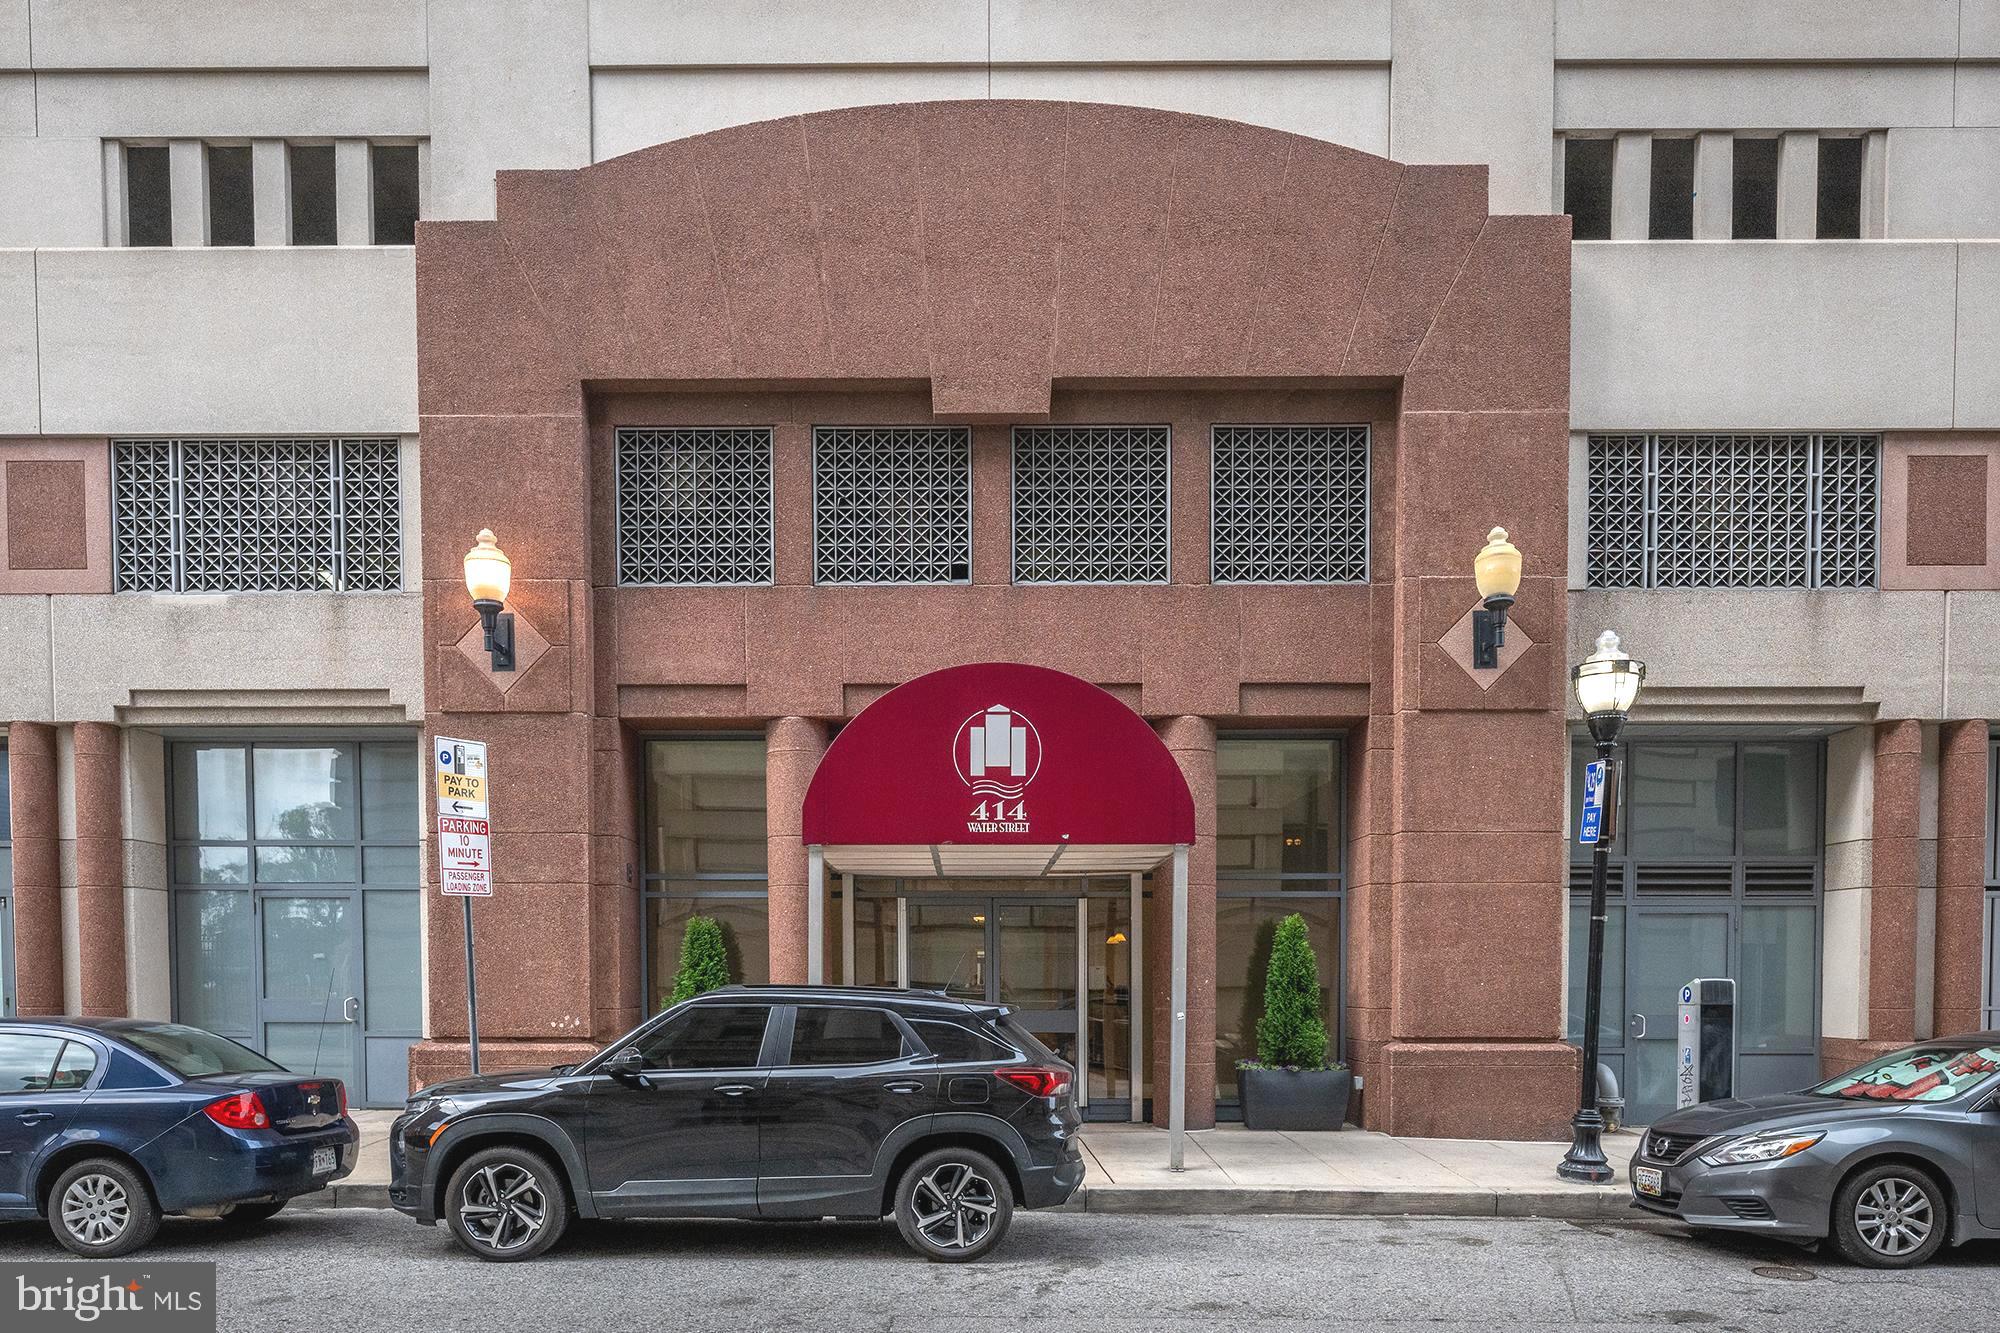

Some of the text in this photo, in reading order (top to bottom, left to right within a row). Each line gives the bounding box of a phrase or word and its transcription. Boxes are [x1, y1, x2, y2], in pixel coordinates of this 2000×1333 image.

[444, 775, 479, 788] PAY TO
[448, 786, 475, 799] PARK
[969, 799, 1027, 821] 414
[1586, 812, 1597, 823] PAY
[441, 818, 486, 834] PARKING
[967, 822, 1030, 833] WATER STREET
[1583, 826, 1597, 837] HERE
[459, 835, 470, 847] 10
[448, 847, 483, 859] MINUTE
[448, 871, 485, 881] PASSENGER
[446, 881, 487, 893] LOADING ZONE
